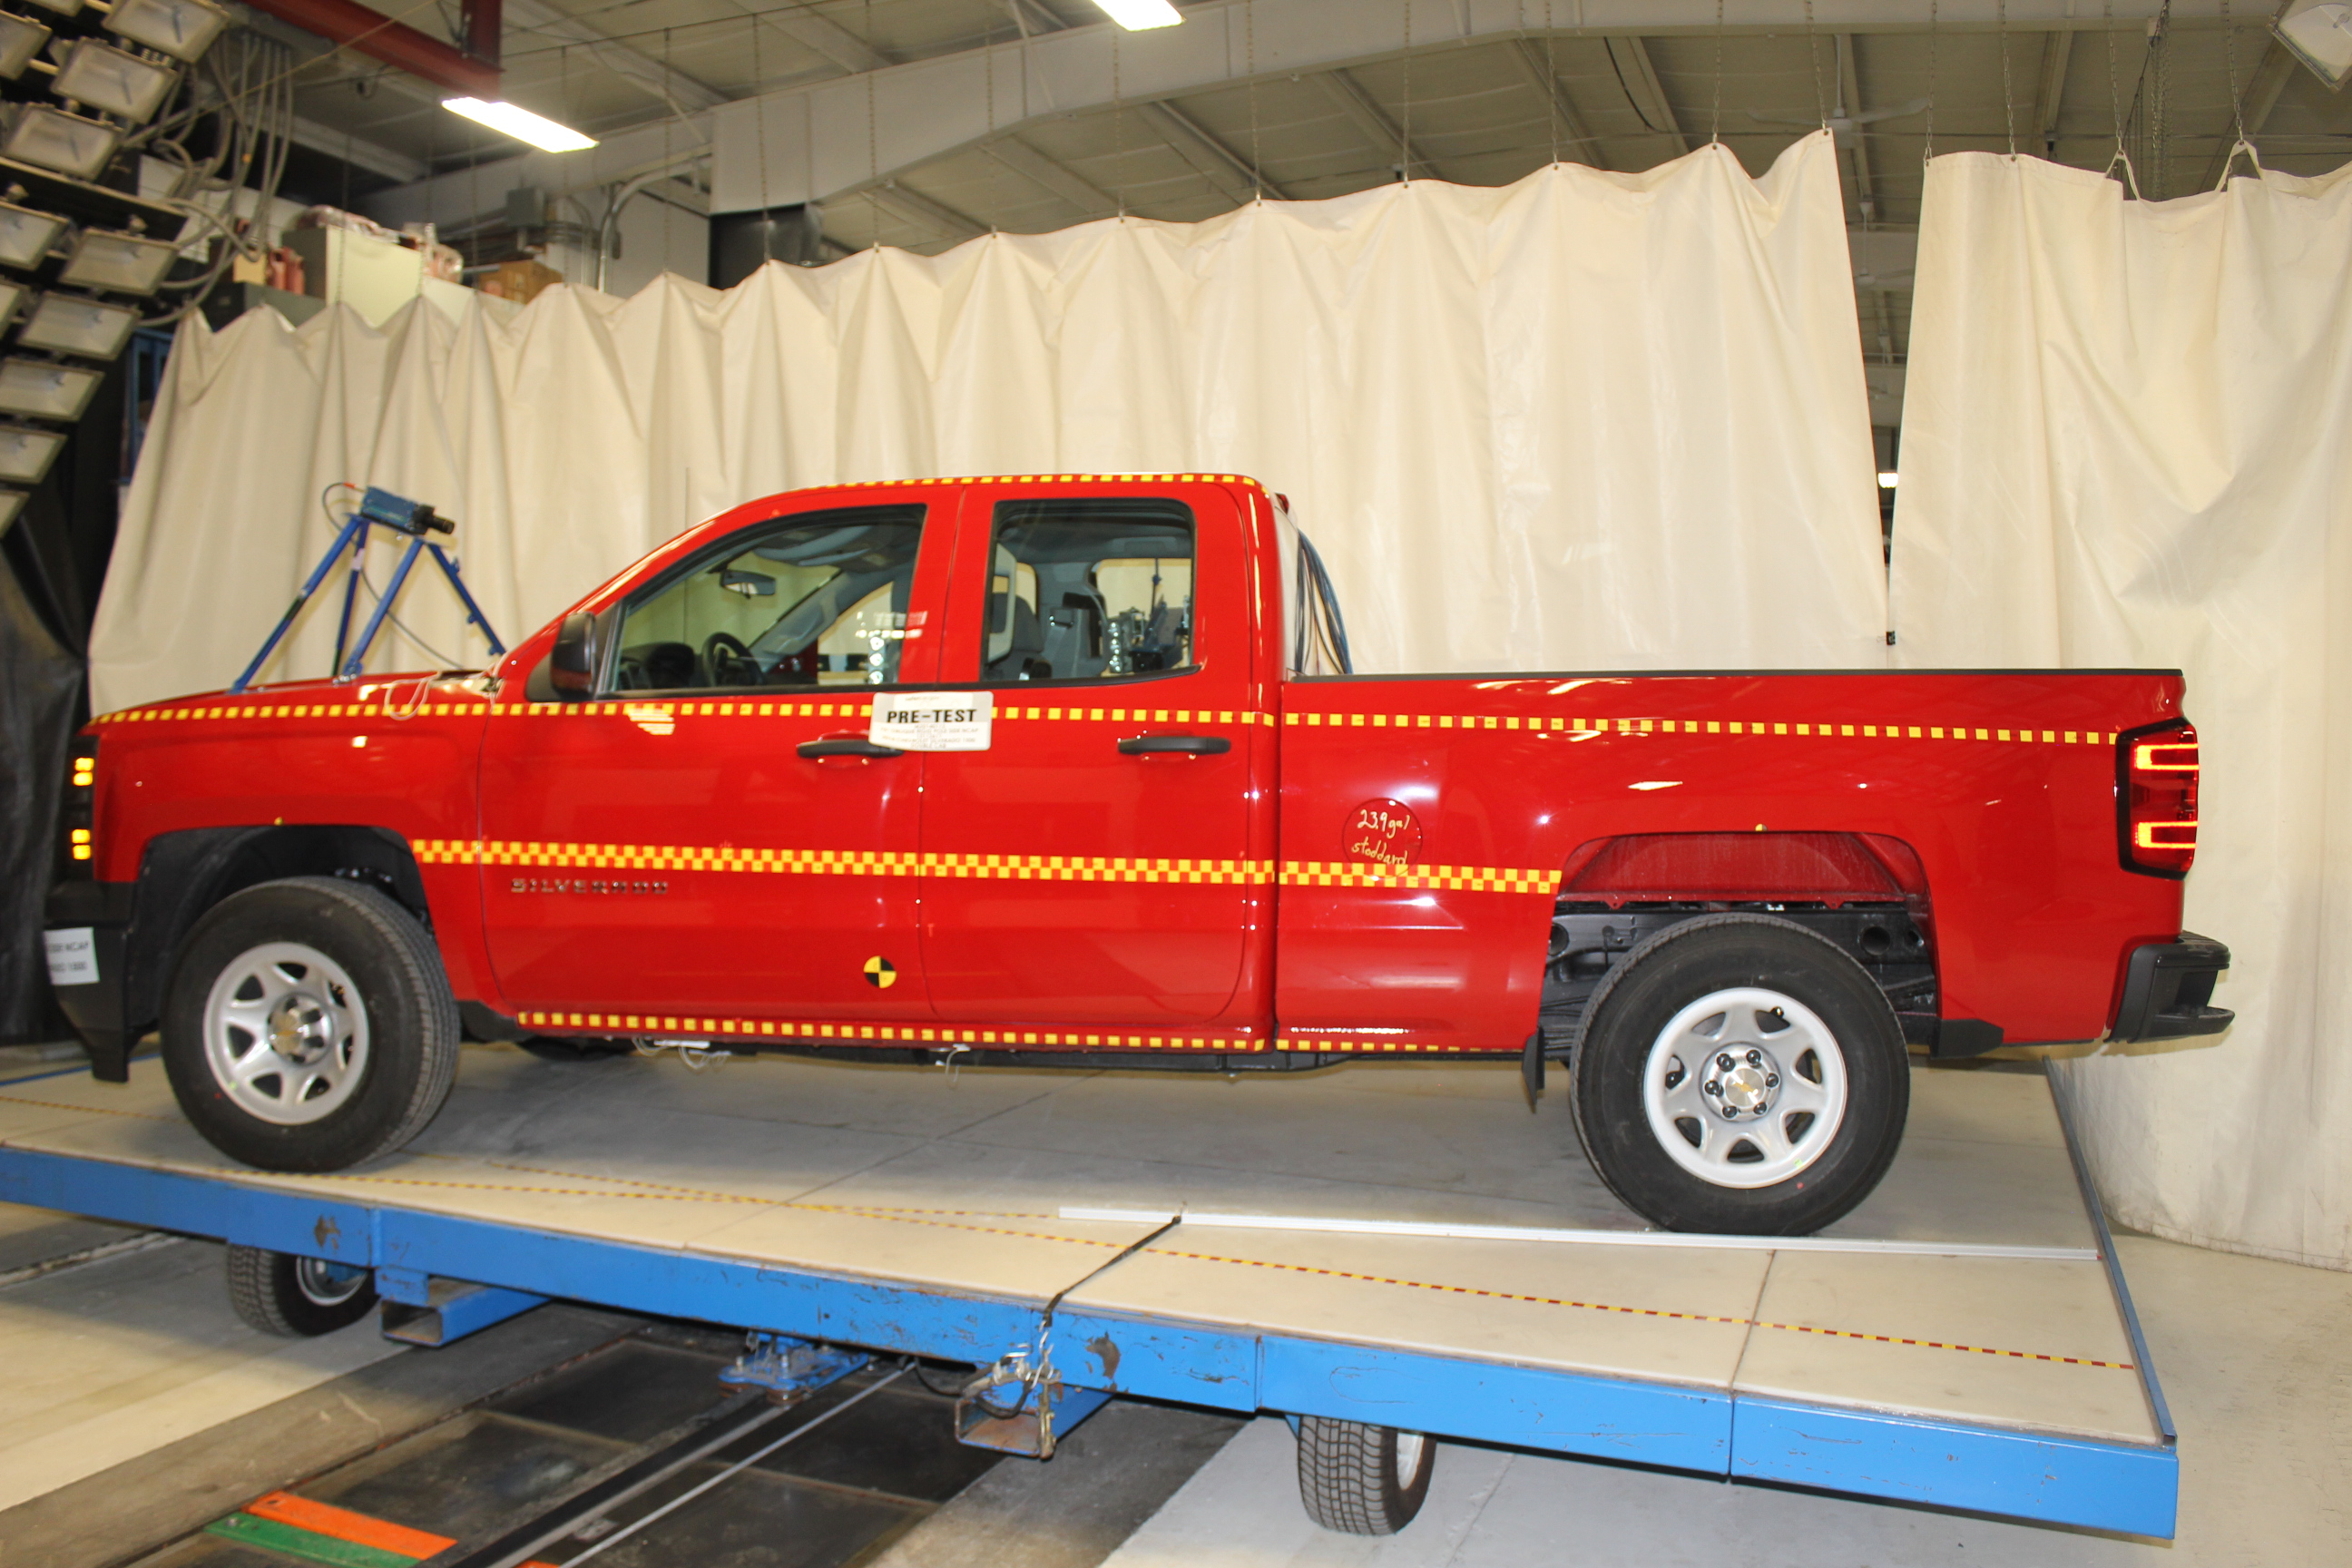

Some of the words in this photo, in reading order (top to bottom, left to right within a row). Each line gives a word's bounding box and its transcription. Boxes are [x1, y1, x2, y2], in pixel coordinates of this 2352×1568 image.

[887, 709, 976, 723] PRE-TEST
[1351, 836, 1407, 865] stoddard
[511, 877, 668, 895] SILVERADO
